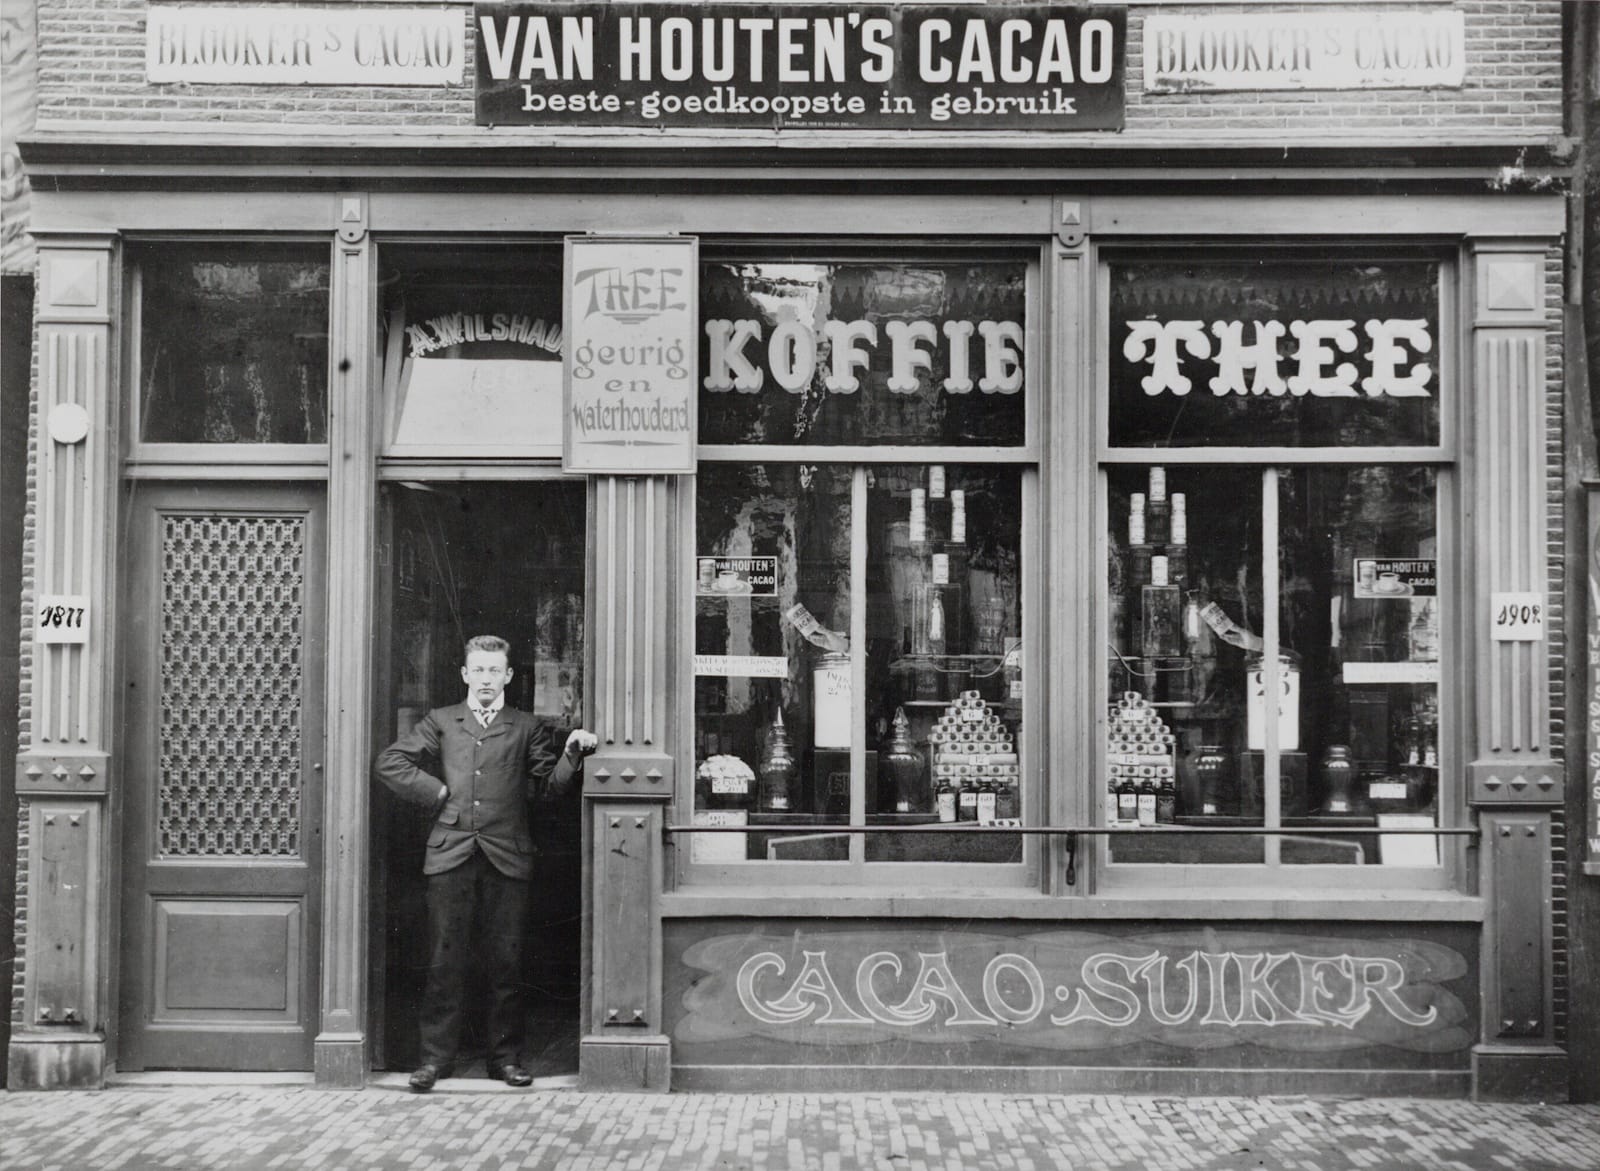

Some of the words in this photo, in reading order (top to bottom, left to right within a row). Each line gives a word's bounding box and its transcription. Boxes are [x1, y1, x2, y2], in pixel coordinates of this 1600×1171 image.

[354, 23, 454, 68] CACAO
[480, 16, 594, 81] VAN
[619, 13, 894, 83] HOUTEN'S
[920, 18, 1113, 84] CACAO
[1353, 26, 1453, 70] CACAO
[880, 90, 916, 115] in
[930, 87, 1077, 121] gebruik
[574, 266, 687, 320] THEE
[573, 337, 689, 380] geurig
[704, 318, 1024, 395] KOFFIE
[1123, 319, 1432, 398] THEE
[604, 379, 652, 393] en
[716, 562, 731, 570] VAN
[747, 575, 774, 585] CACAO
[40, 604, 85, 629] 1877
